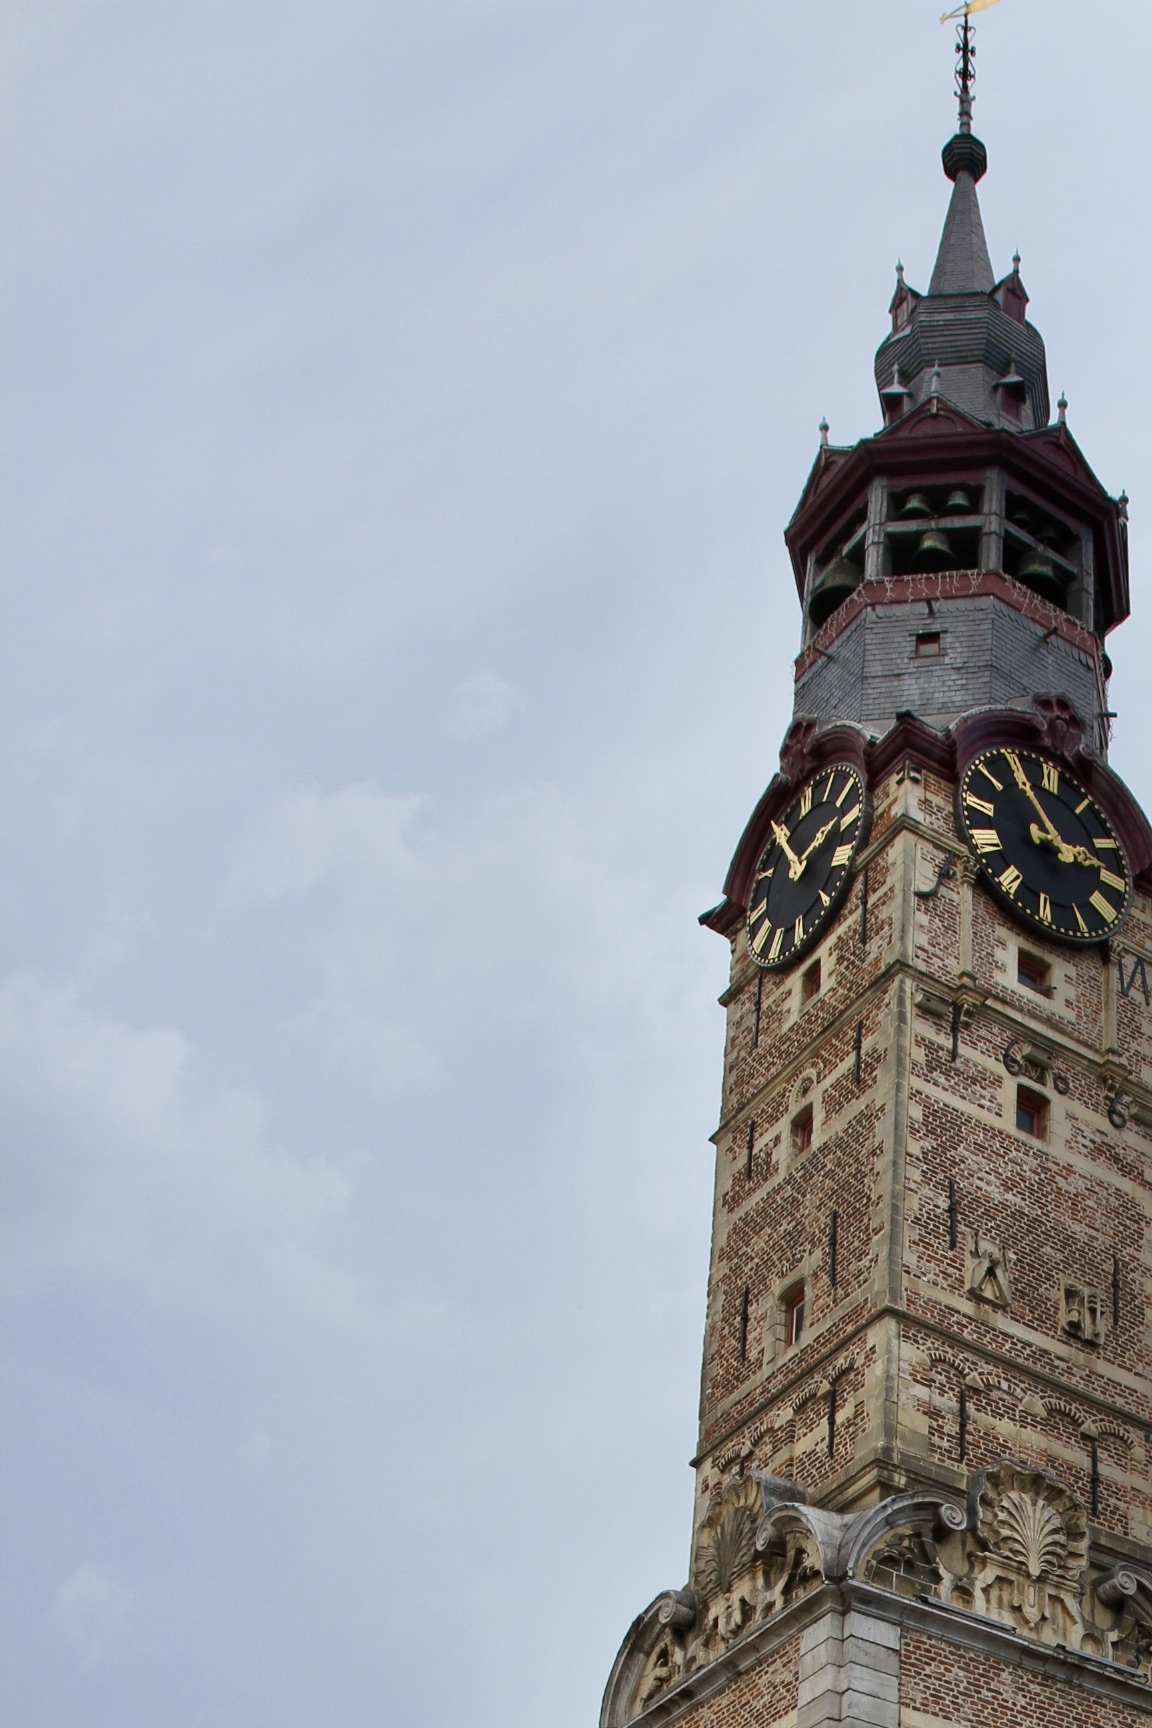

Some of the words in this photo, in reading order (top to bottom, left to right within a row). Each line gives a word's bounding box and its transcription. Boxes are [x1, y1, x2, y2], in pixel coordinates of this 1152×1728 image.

[977, 763, 1003, 791] X
[1041, 763, 1059, 795] XII
[966, 791, 994, 817] IX
[1075, 798, 1090, 815] I
[971, 829, 1003, 854] VIII
[1092, 838, 1117, 849] II
[998, 864, 1023, 897] VII
[1100, 867, 1126, 893] III
[1040, 892, 1051, 923] VI
[1072, 902, 1088, 932] V
[1089, 889, 1117, 923] IIII
